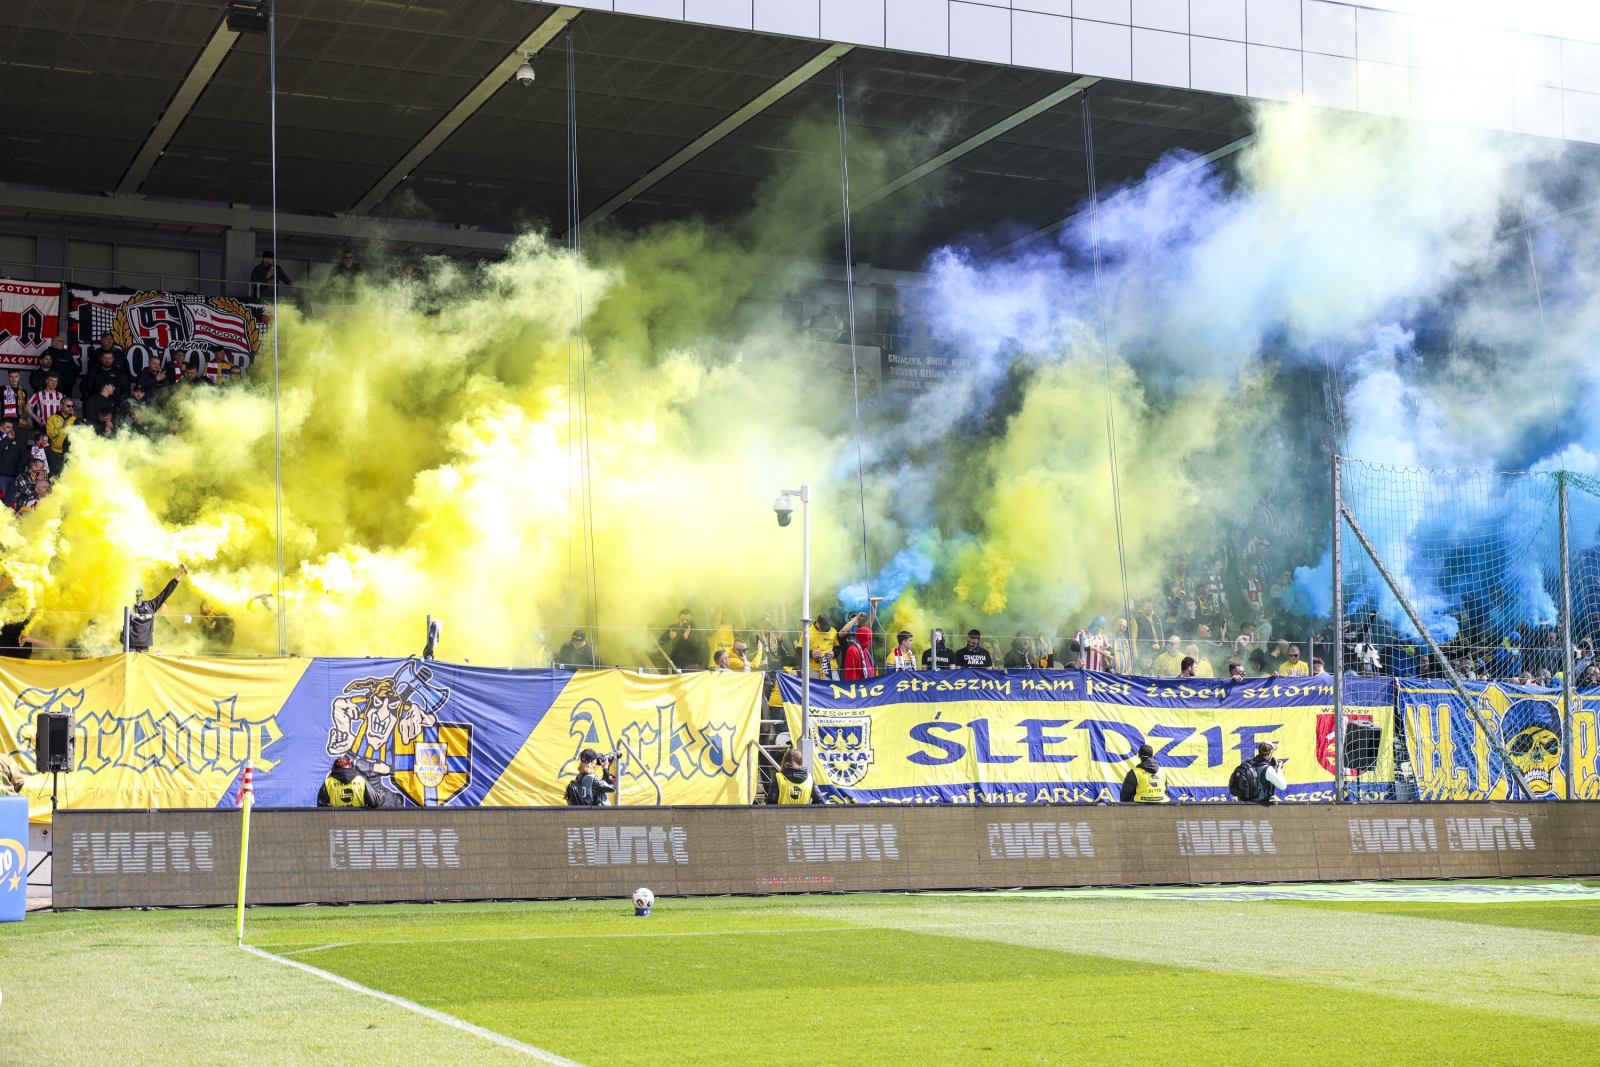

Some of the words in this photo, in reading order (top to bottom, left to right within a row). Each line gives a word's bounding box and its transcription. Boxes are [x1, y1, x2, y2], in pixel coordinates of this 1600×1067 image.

[0, 285, 45, 294] GOTOWI
[193, 307, 207, 317] KS
[199, 325, 243, 342] CRACOVIA
[168, 341, 208, 352] CRACOVIA
[0, 356, 38, 364] ACOVI
[926, 356, 948, 366] SMOK
[920, 369, 946, 379] DZIURA
[829, 683, 885, 699] Nie
[896, 677, 1012, 695] straszny
[1021, 678, 1074, 692] nam
[1086, 676, 1132, 695] jest
[1147, 682, 1227, 699] żaden
[1242, 684, 1335, 699] sztorm
[558, 698, 740, 781] Arka
[906, 711, 1290, 768] ŚLEDZIE
[818, 753, 868, 761] ARKA
[1033, 787, 1117, 803] ARKA
